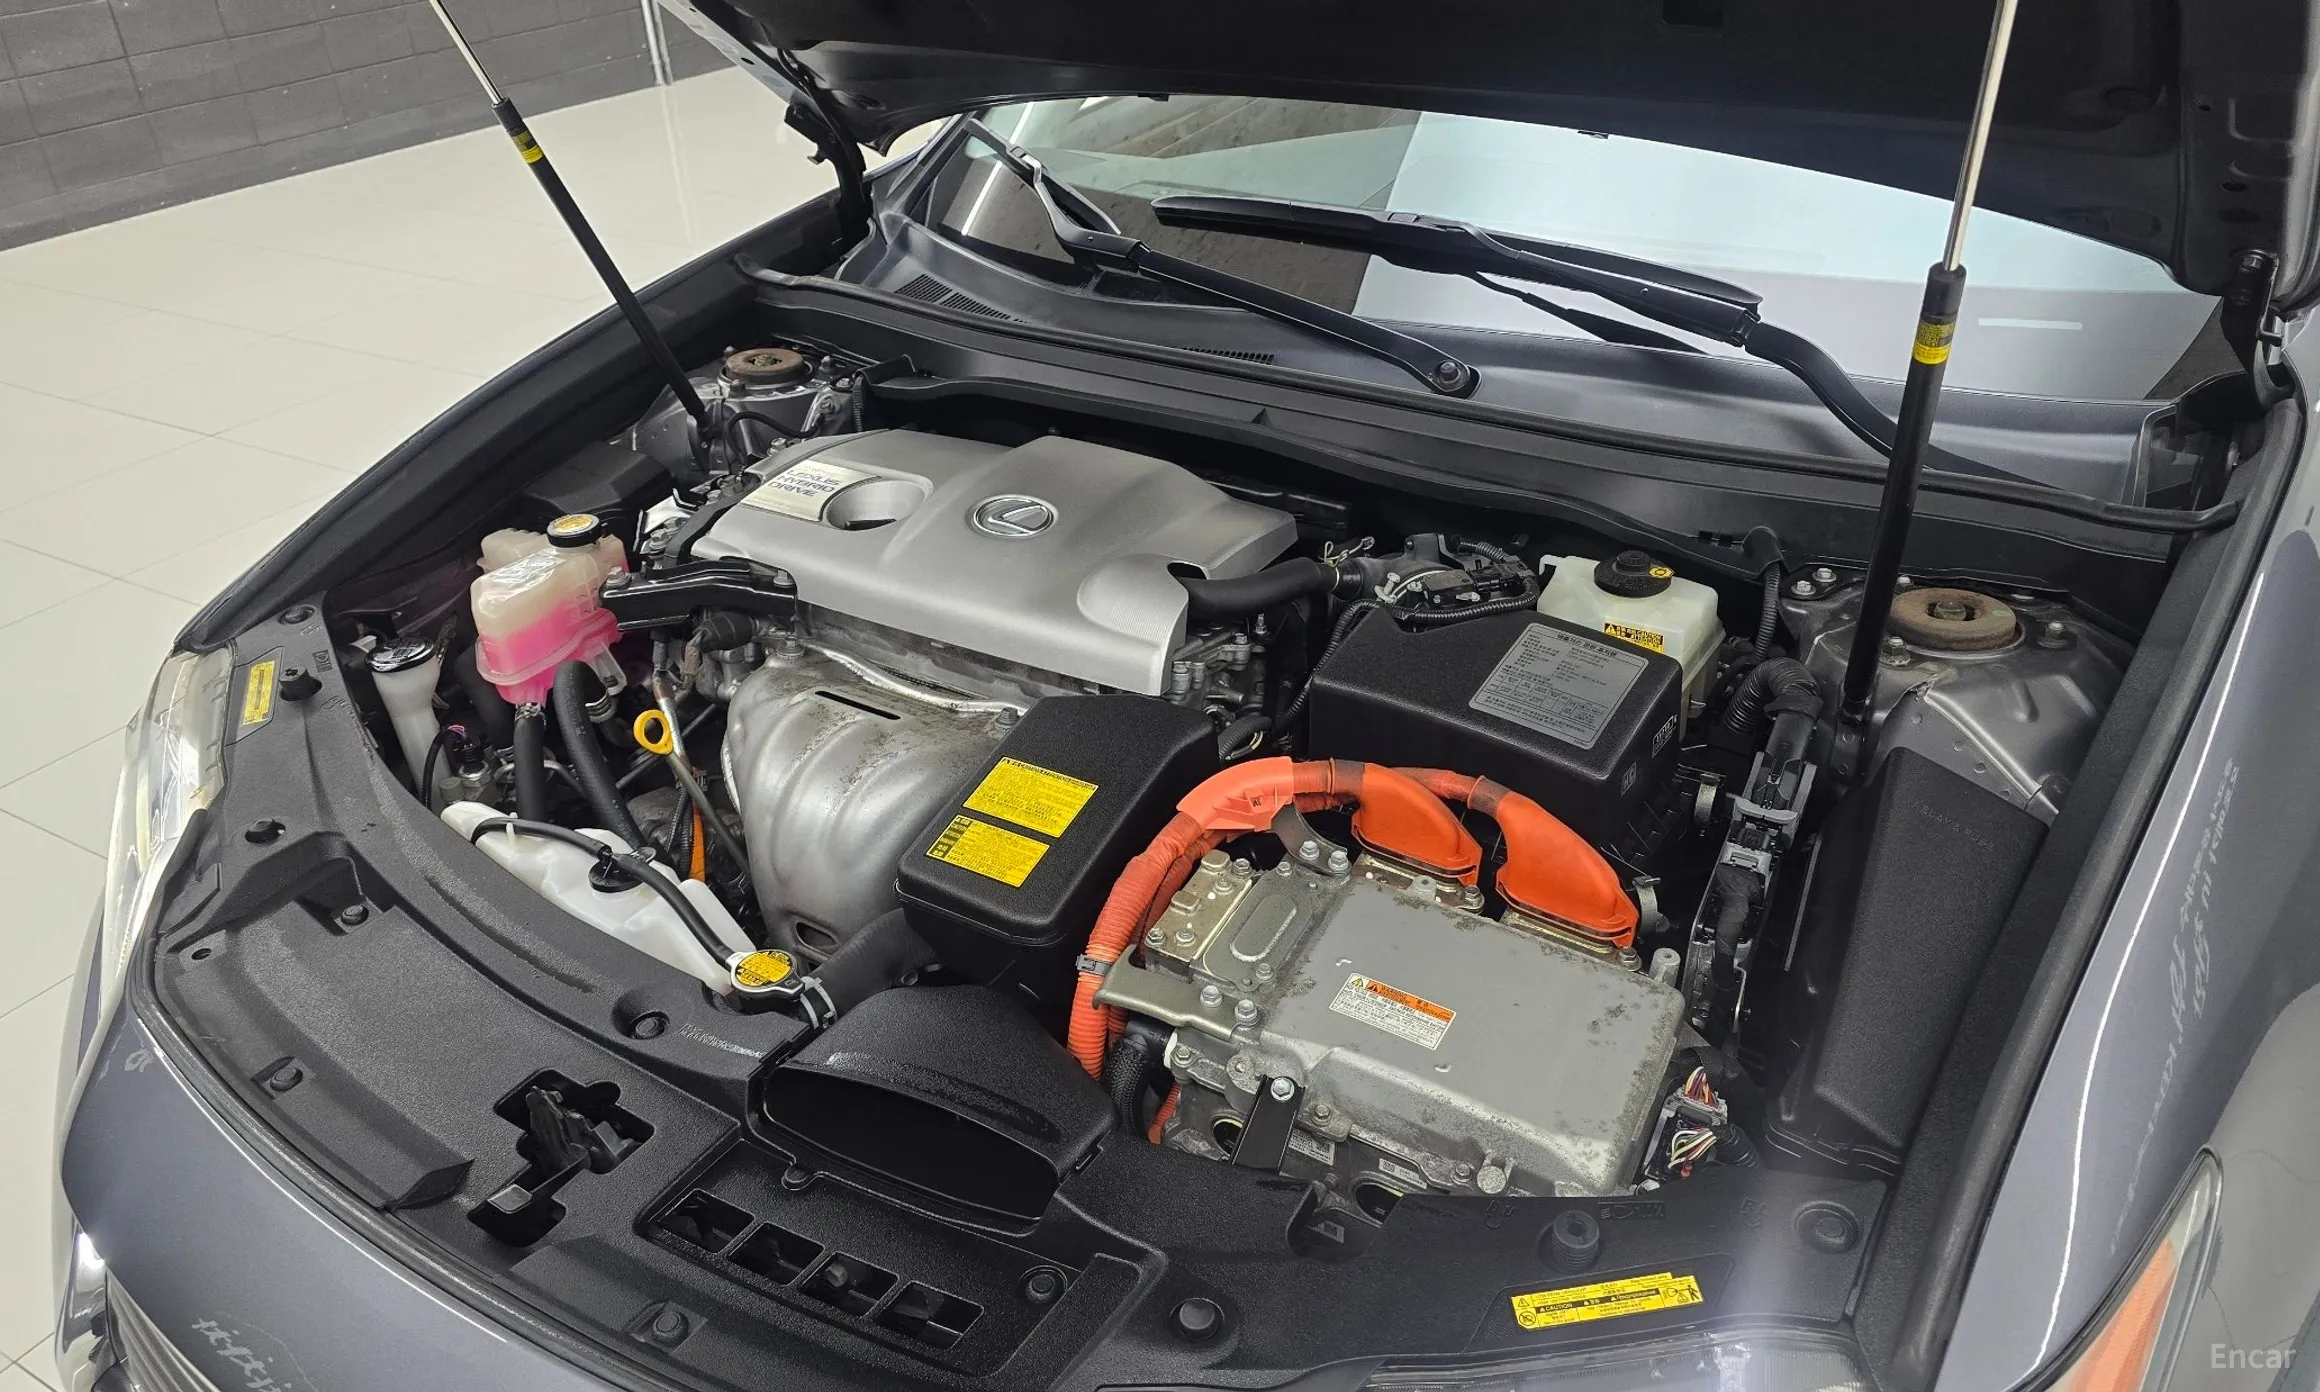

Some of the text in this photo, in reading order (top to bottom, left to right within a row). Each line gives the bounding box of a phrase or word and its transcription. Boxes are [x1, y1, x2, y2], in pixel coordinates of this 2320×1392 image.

[777, 475, 835, 493] HYBRID
[786, 469, 841, 486] LEXUS
[768, 482, 817, 497] DRIVE
[1546, 1303, 1573, 1312] CAUTION
